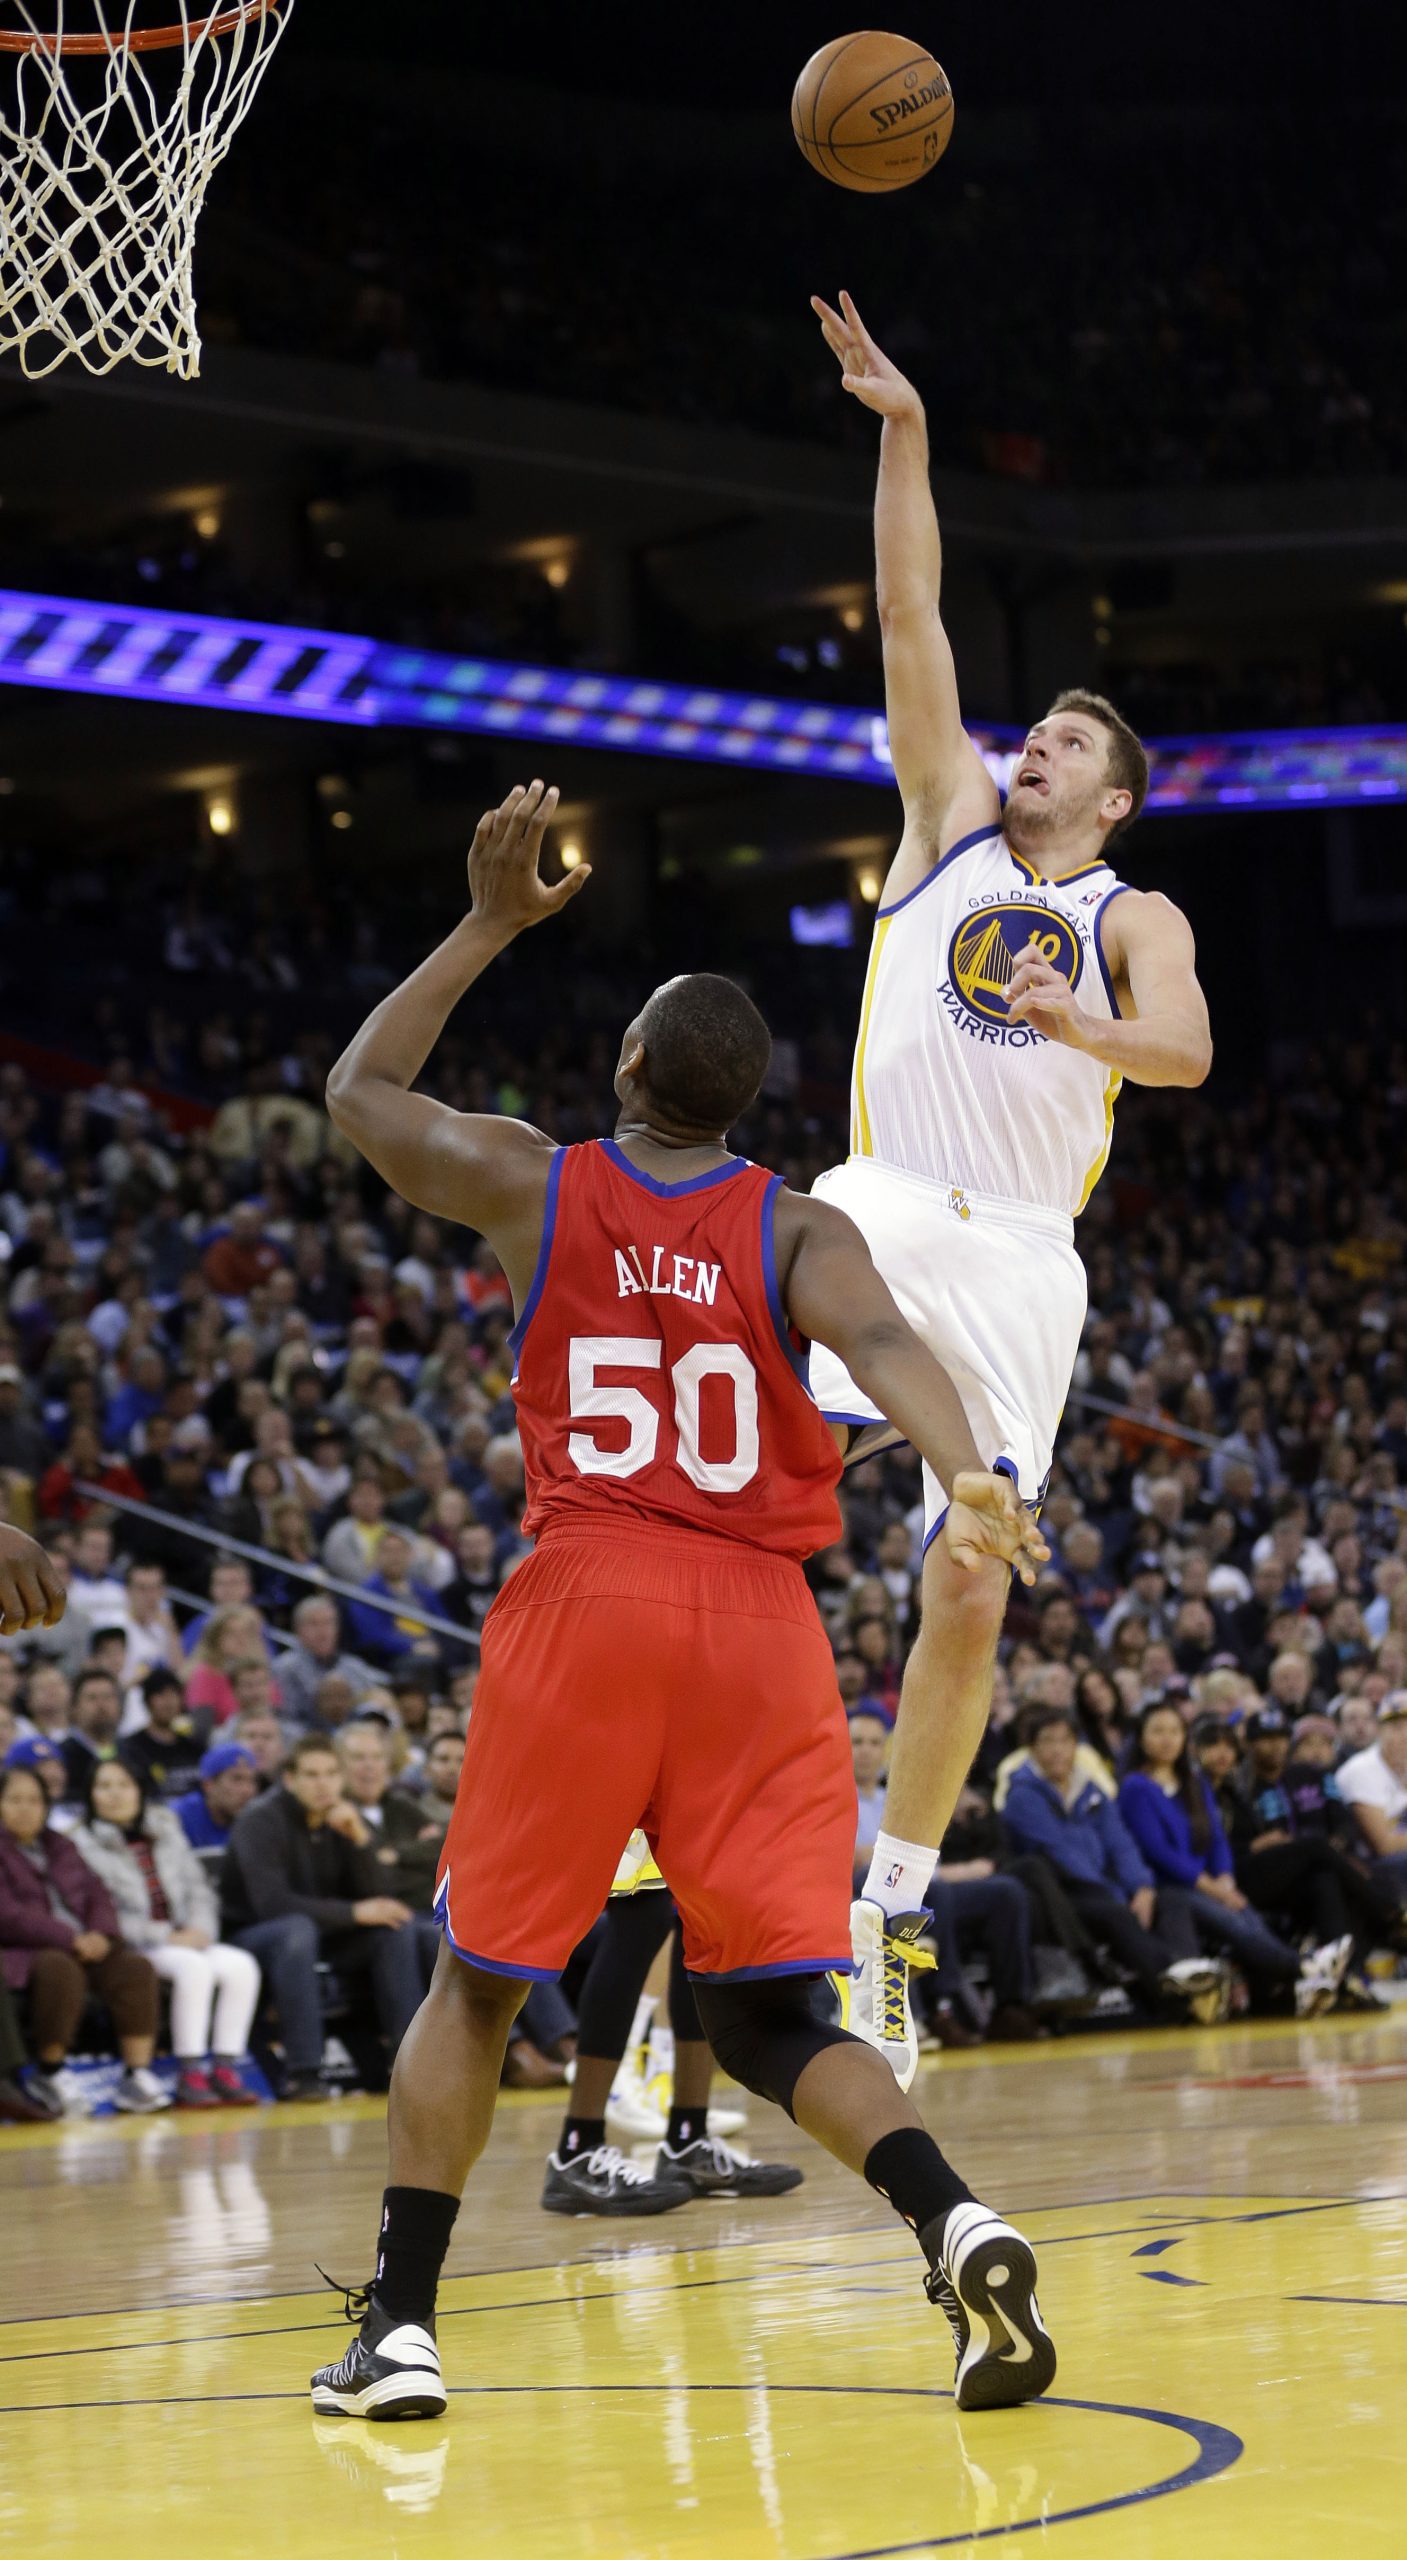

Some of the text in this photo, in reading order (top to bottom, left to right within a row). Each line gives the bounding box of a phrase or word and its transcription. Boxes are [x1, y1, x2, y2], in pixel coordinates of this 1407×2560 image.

[870, 72, 951, 133] SPALDIN
[968, 890, 1091, 946] GOLDEN TATE
[1027, 929, 1061, 963] 10
[936, 980, 1049, 1048] WARRIOR
[613, 1244, 721, 1306] ALLEN
[567, 1336, 759, 1493] 50
